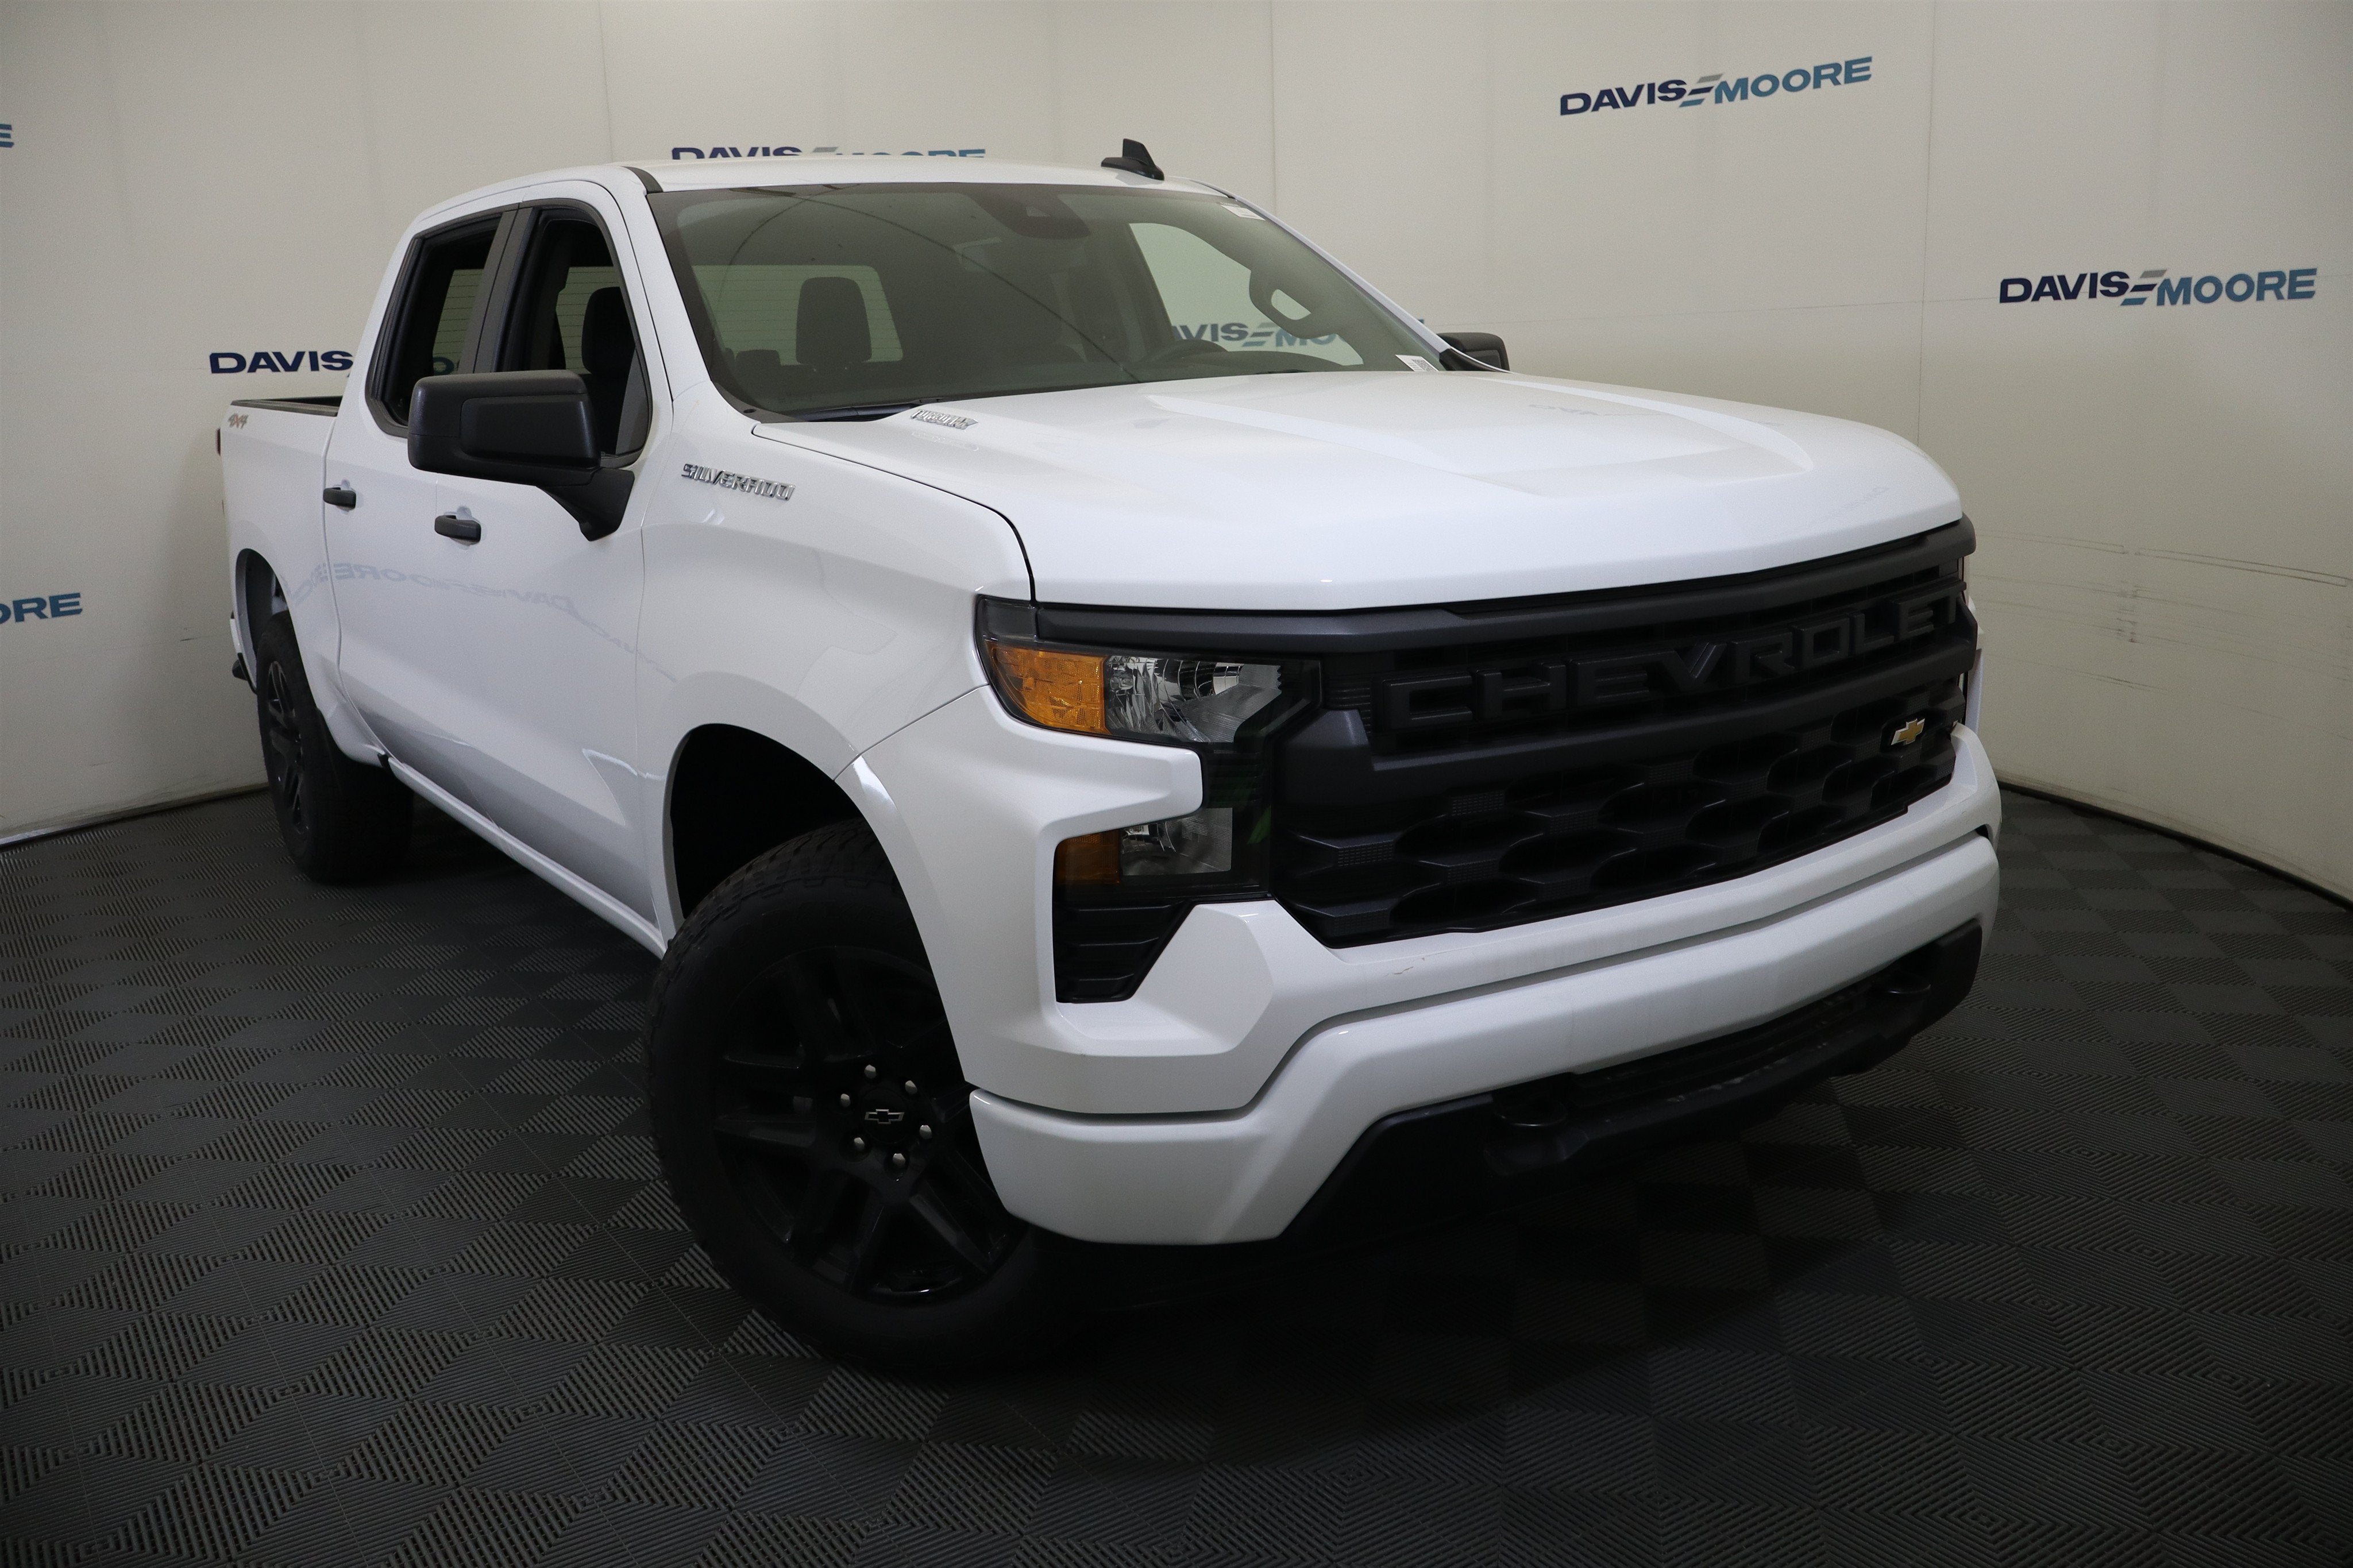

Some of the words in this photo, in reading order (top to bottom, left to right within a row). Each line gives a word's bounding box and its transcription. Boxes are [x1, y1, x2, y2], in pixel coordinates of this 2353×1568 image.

[1560, 79, 1687, 116] DAVIS
[1715, 56, 1873, 105] MOORE
[1999, 271, 2130, 303] DAVIS
[2156, 268, 2317, 306] MOORE
[209, 350, 353, 374] DAVIS
[681, 463, 796, 501] SILVERADO
